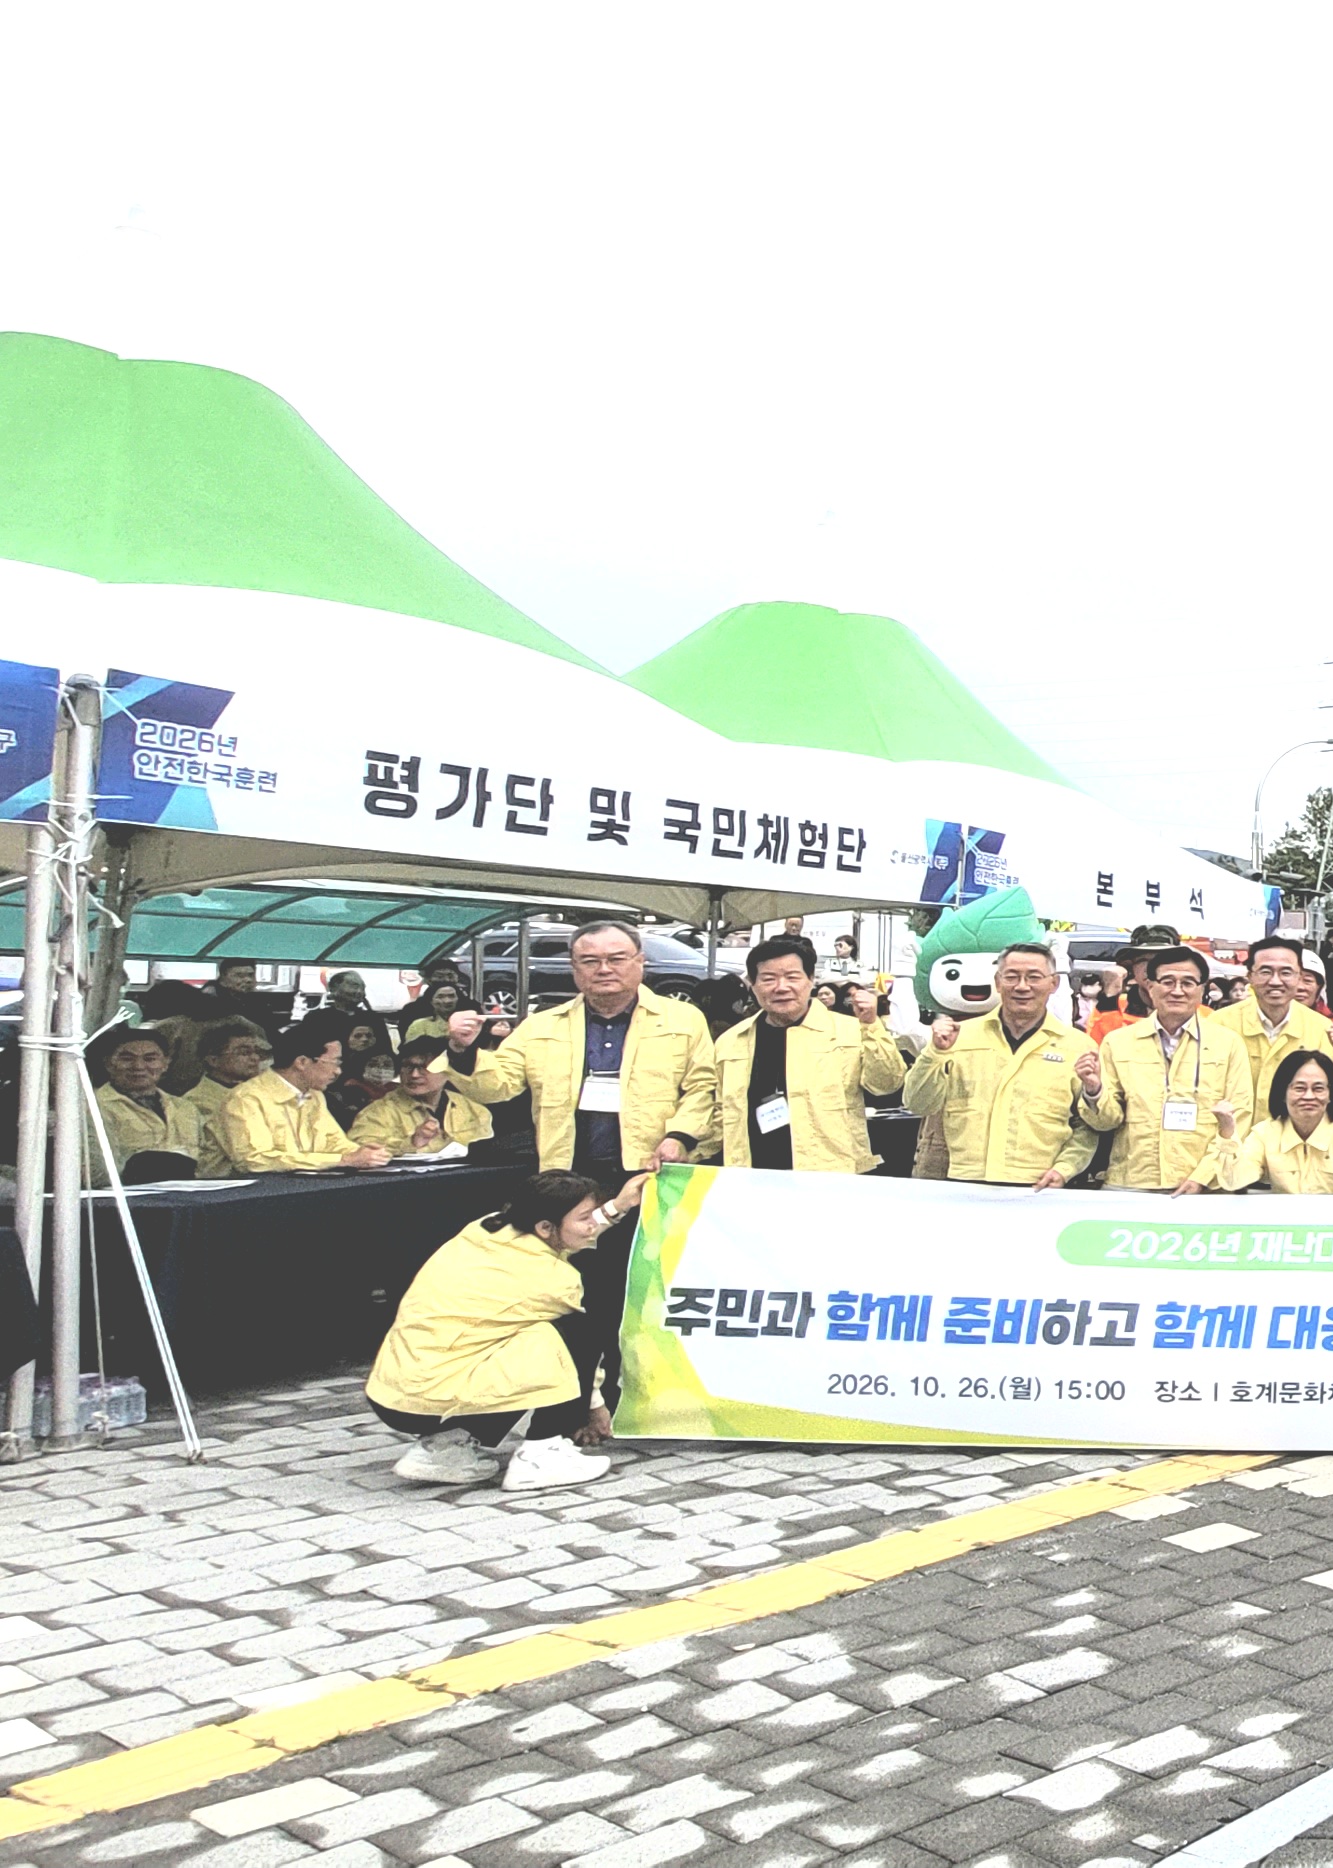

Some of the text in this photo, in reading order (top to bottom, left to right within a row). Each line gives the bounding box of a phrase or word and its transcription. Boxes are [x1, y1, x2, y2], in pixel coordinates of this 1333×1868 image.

[138, 721, 238, 757] 2026년
[137, 752, 278, 793] 안전한국훈련
[363, 749, 868, 873] 평가단 및 국민체험단
[1105, 1228, 1241, 1263] 2026년
[663, 1287, 816, 1339] 주민과
[826, 1290, 933, 1343] 함께
[942, 1296, 1141, 1348] 준비하고
[1153, 1302, 1259, 1351] 함께
[827, 1374, 897, 1399] 2026.
[911, 1377, 946, 1400] 10.
[958, 1376, 1043, 1403] 26.(월)
[1056, 1380, 1127, 1402] 15:00
[1154, 1380, 1203, 1404] 장소
